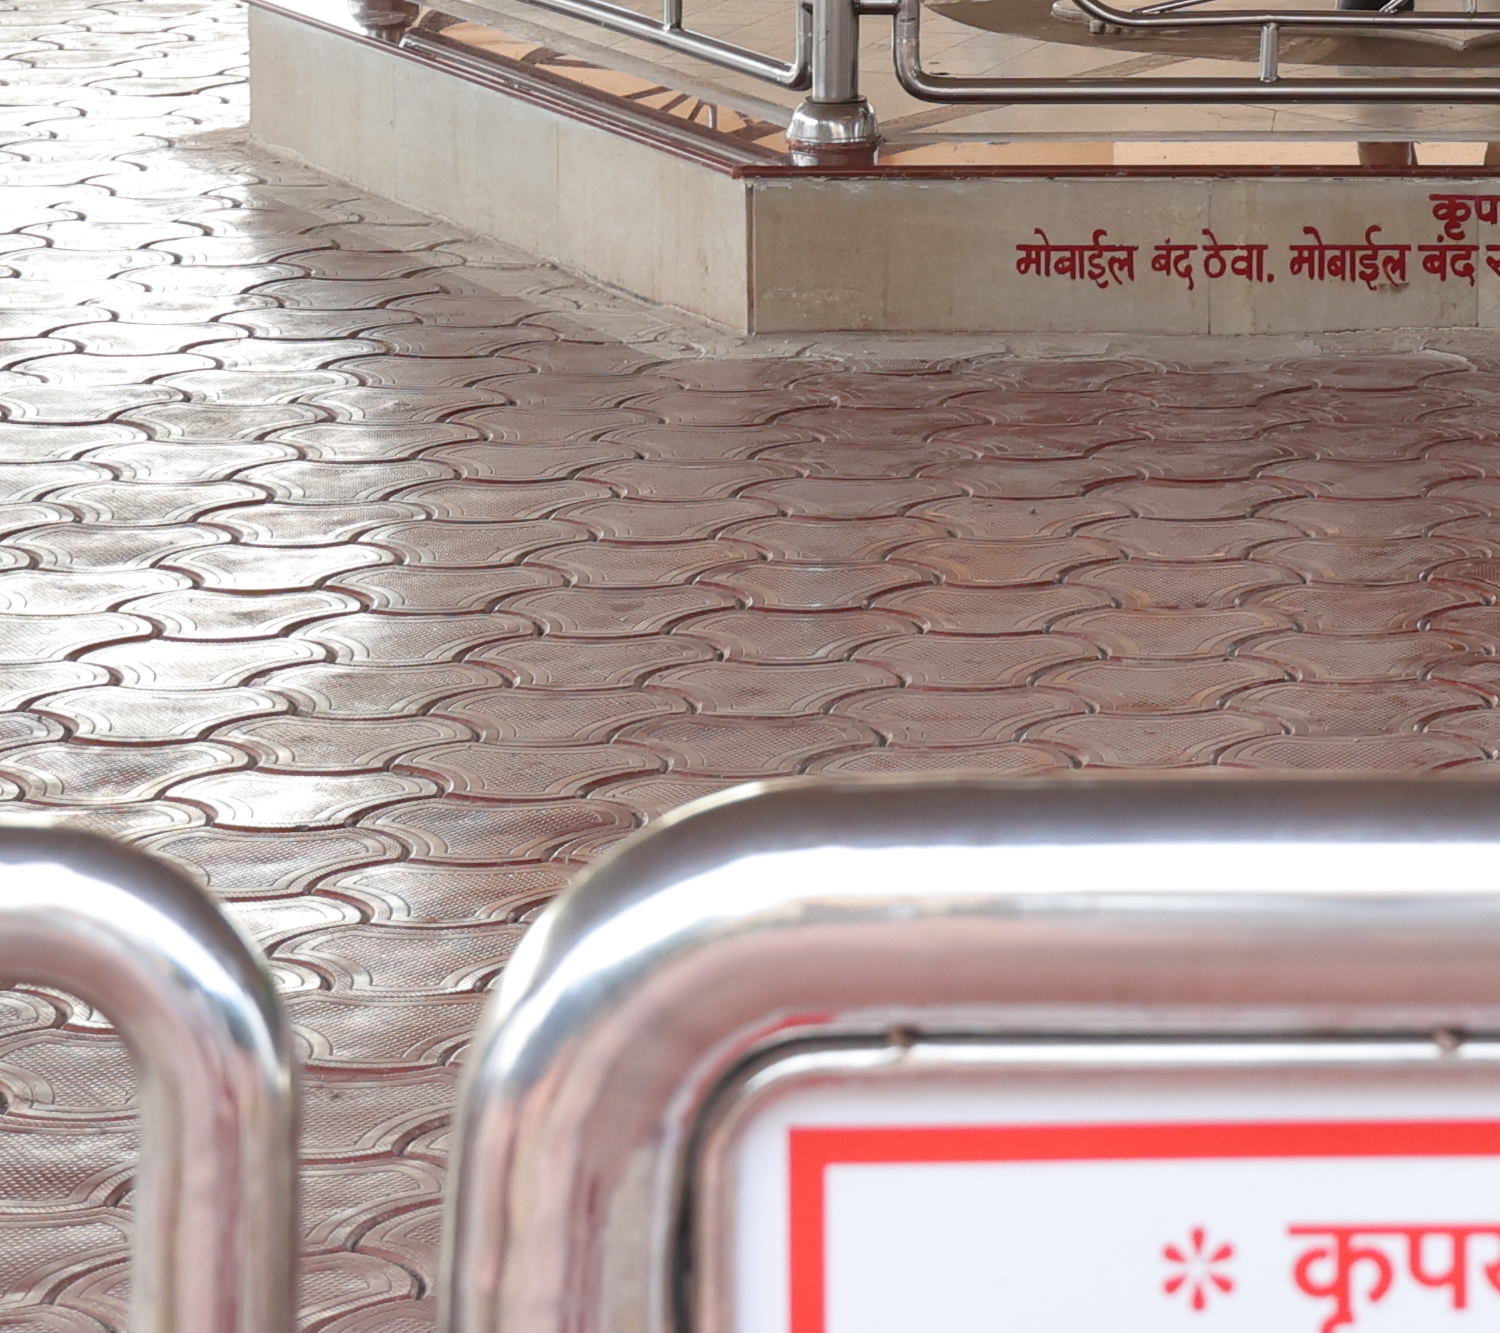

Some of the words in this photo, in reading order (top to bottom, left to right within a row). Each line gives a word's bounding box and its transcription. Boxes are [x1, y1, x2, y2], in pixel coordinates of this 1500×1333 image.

[1016, 229, 1137, 288] मोबाईल
[1152, 237, 1197, 290] बंद
[1202, 228, 1274, 283] ठेवा.
[1289, 225, 1412, 290] मोबाईल
[1417, 233, 1479, 288] बंद
